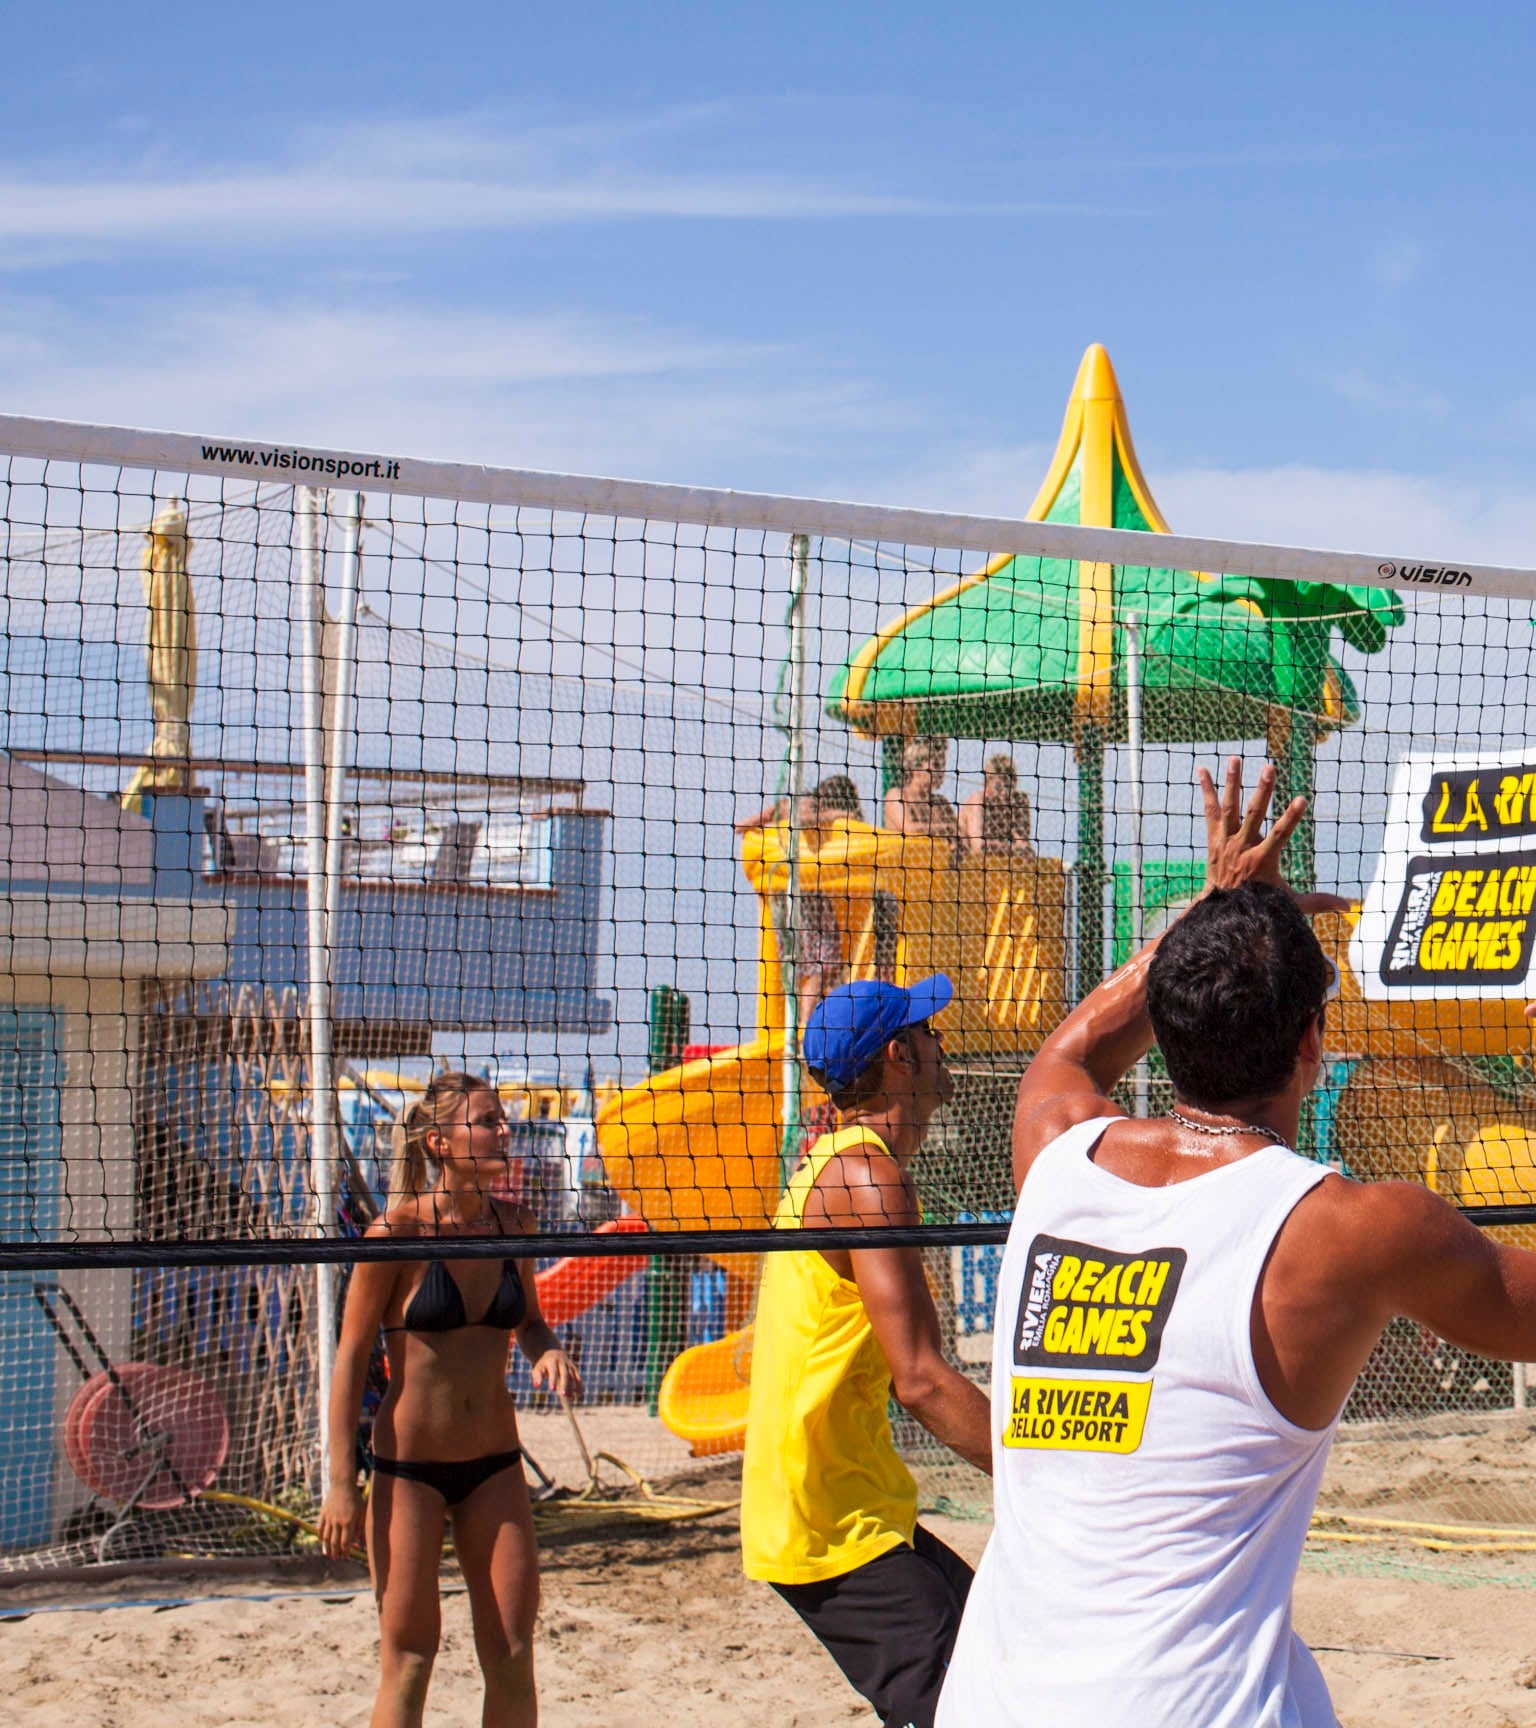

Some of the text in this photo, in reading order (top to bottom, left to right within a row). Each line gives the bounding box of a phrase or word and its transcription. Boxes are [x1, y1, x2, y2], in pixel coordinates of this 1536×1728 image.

[201, 445, 401, 480] www.visionsport.it
[1399, 565, 1473, 587] vision
[1431, 778, 1488, 833] LA
[1389, 871, 1433, 971] RIVIERA
[1419, 920, 1527, 970] GAMES
[1020, 1252, 1055, 1351] RIVIERA
[1031, 1254, 1061, 1347] EMILIA ROMAGNA
[1052, 1255, 1171, 1306] BEACH
[1043, 1305, 1153, 1357] GAMES
[1012, 1387, 1129, 1419] LA RIVIERA
[1011, 1417, 1128, 1444] DELLO SPORT
